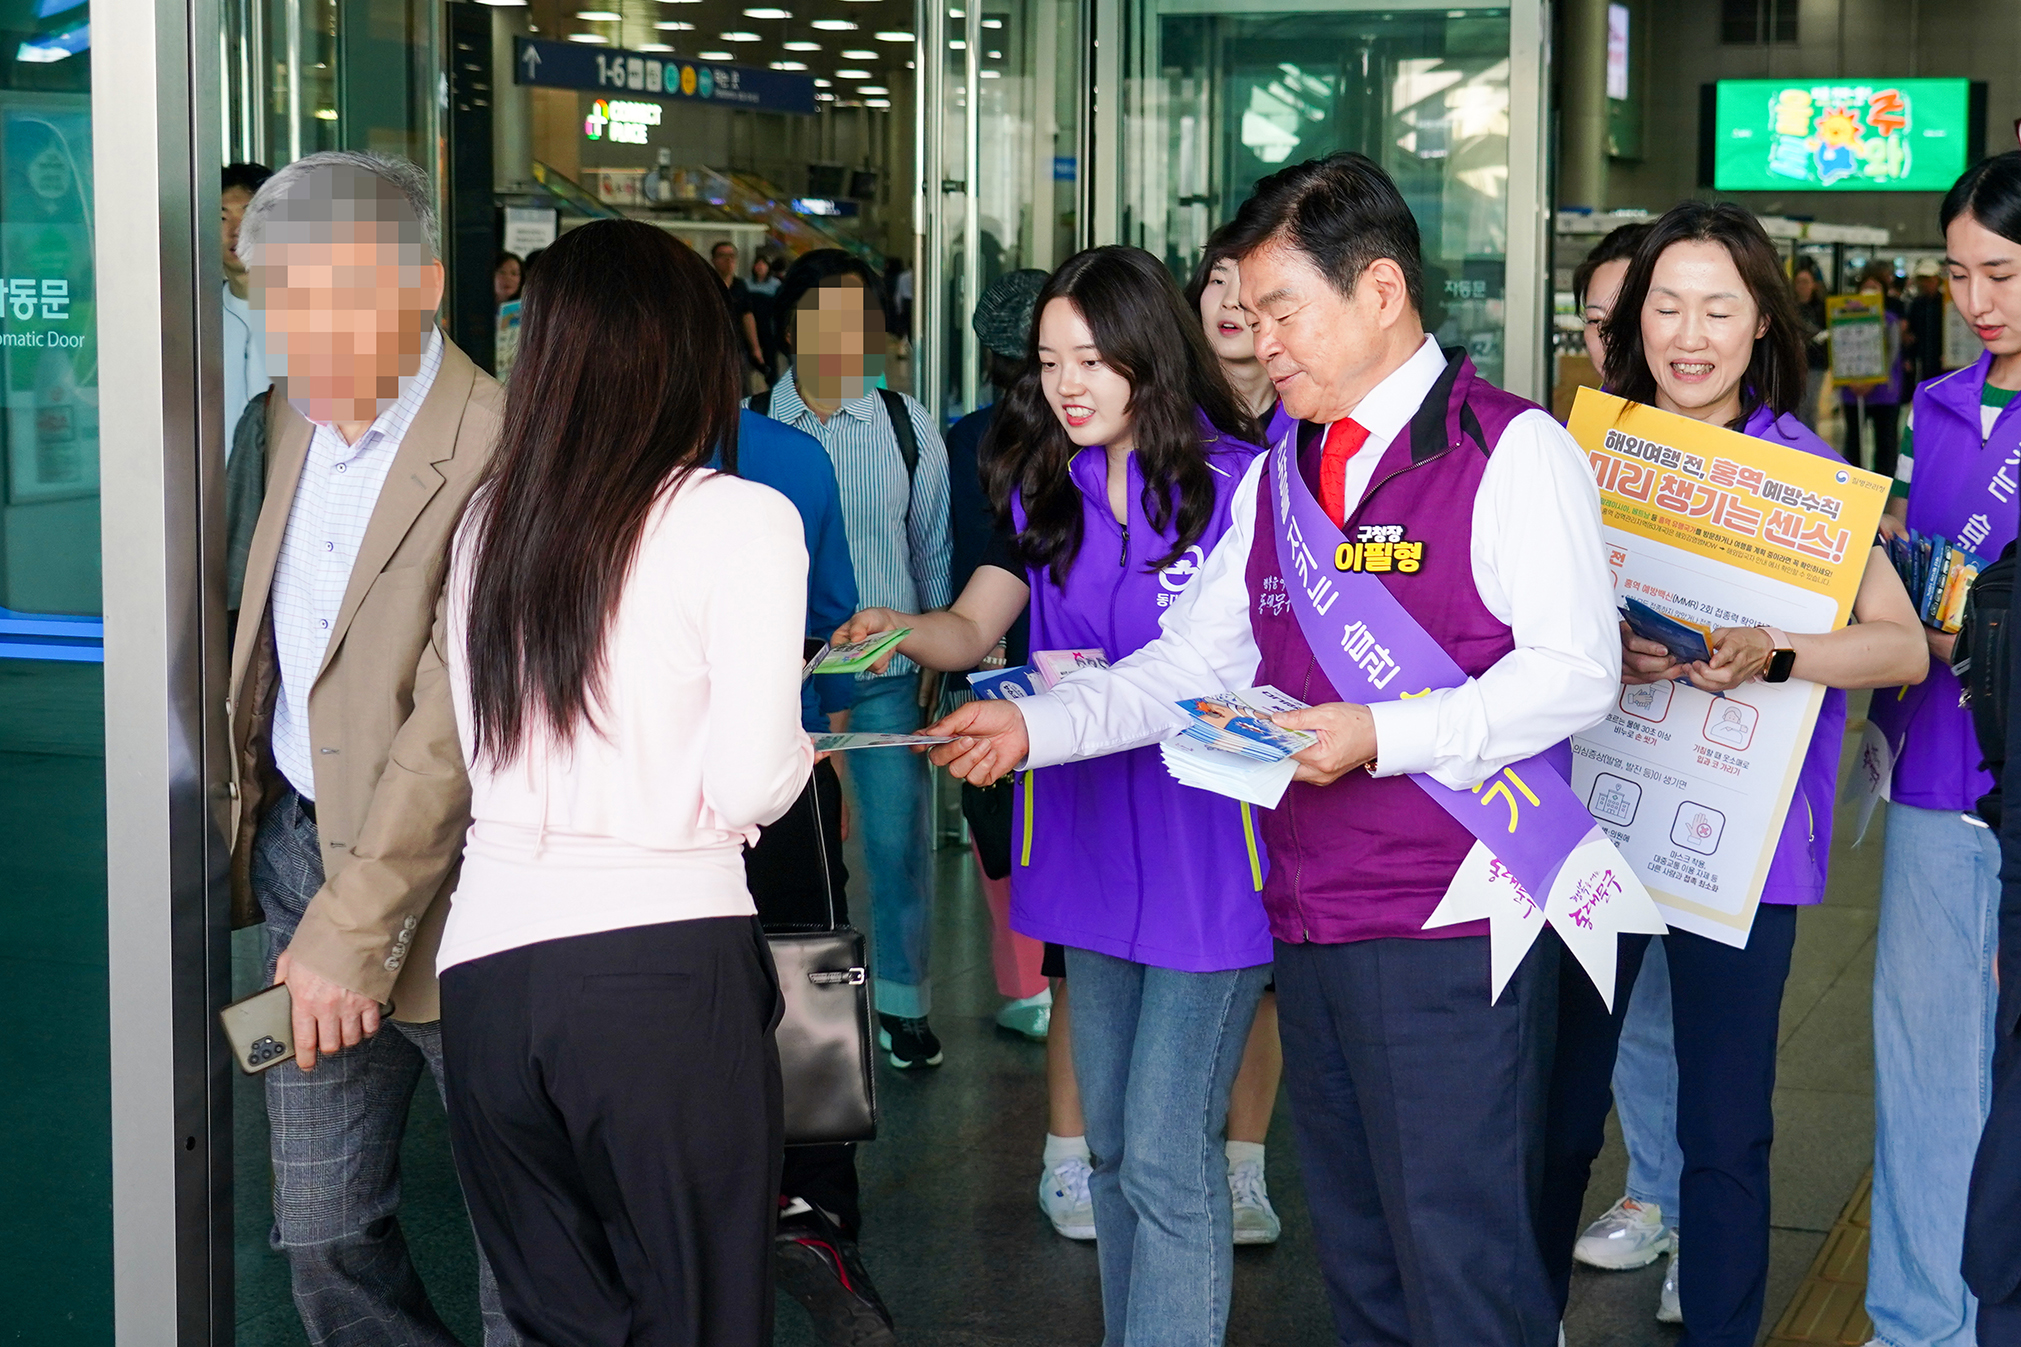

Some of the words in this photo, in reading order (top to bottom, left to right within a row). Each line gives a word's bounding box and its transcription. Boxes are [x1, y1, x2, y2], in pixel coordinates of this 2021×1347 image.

[596, 52, 626, 88] 1-6
[0, 279, 69, 320] 동문
[1444, 280, 1486, 298] 자동문
[48, 331, 85, 347] Door
[1604, 430, 1682, 468] 해외여행
[1681, 454, 1708, 479] 전,
[1708, 458, 1763, 495] 홍역
[1761, 479, 1841, 518] 예방수칙
[1851, 477, 1885, 493] 질병관리청
[1587, 452, 1656, 501] 미리
[1654, 473, 1763, 535] 챙기는
[1762, 508, 1849, 563] 센스!
[1357, 525, 1404, 543] 구청장
[1650, 513, 1657, 522] 등
[1658, 516, 1671, 526] 홍역
[1702, 530, 1733, 545] 방문하거나
[1733, 540, 1752, 551] 여행을
[1753, 546, 1766, 556] 계획
[1766, 551, 1791, 564] 중이라면
[1799, 561, 1833, 577] 확인하세요!
[1286, 515, 1340, 616] 지키는
[1334, 541, 1423, 573] 이필형
[1798, 570, 1805, 578] 수
[1623, 578, 1640, 591] 홍역
[1640, 583, 1699, 610] 예방백신(MMR)
[1699, 602, 1713, 614] 2회
[1714, 607, 1739, 622] 접종력
[1340, 620, 1401, 690] 습관
[1605, 712, 1626, 725] 흐르는
[1626, 719, 1640, 730] 물에
[1640, 724, 1656, 735] 30초
[1656, 730, 1671, 741] 이상
[1613, 725, 1634, 738] 비누로
[1634, 733, 1642, 741] 손
[1642, 735, 1657, 746] 씻기
[1571, 744, 1625, 769] 의심증상(발열,
[1624, 761, 1642, 775] 발진
[1642, 767, 1662, 782] 등)이
[1662, 774, 1687, 790] 생기면
[1692, 744, 1714, 757] 기침할
[1713, 751, 1722, 759] 때
[1722, 754, 1750, 769] 옷소매로
[1696, 755, 1711, 766] 입과
[1711, 760, 1719, 768] 코
[1719, 763, 1740, 776] 가리기
[1652, 854, 1680, 870] 대중교통
[1680, 863, 1695, 875] 이용
[1695, 868, 1710, 880] 자제
[1710, 873, 1718, 883] 등
[1669, 850, 1691, 863] 마스크
[1647, 861, 1661, 873] 다른
[1662, 867, 1683, 880] 사람과
[1698, 879, 1719, 892] 최소화
[1569, 869, 1622, 930] 동대문구
